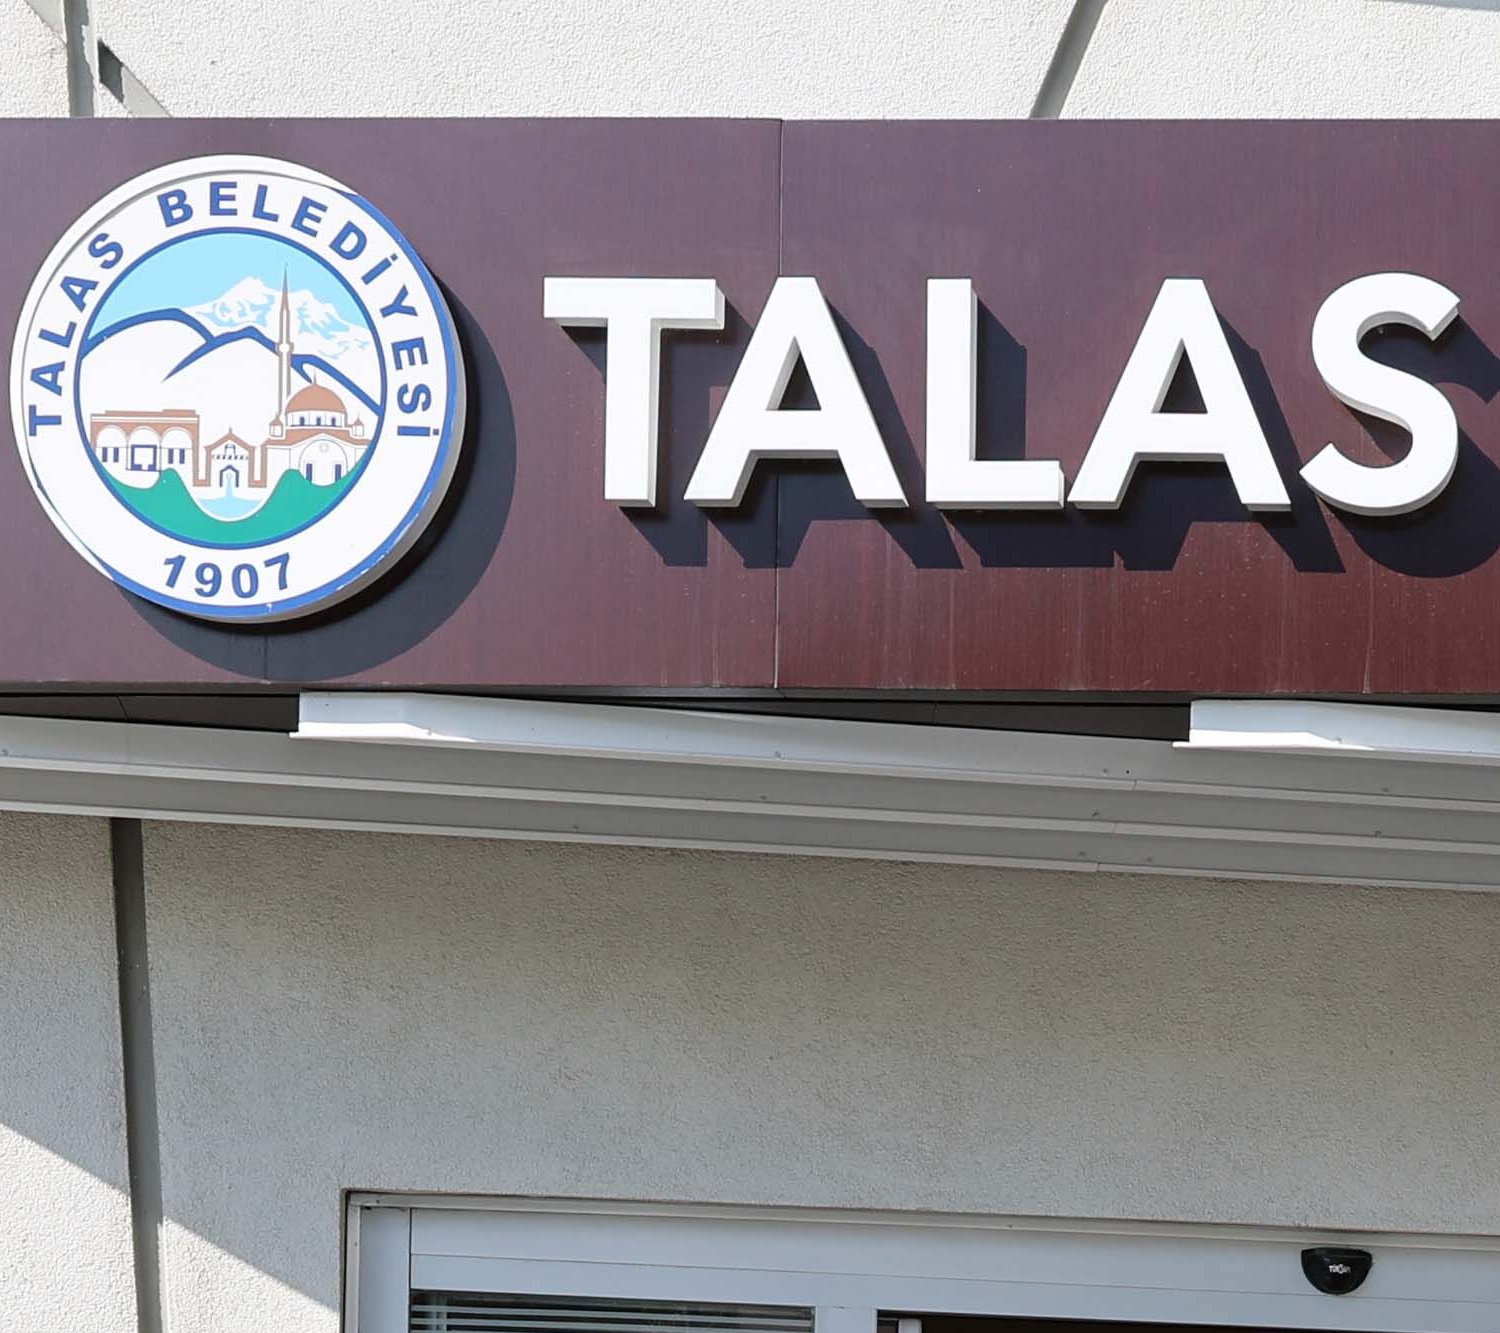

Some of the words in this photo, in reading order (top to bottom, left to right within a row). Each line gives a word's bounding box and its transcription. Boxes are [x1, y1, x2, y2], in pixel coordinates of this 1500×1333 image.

[29, 232, 124, 437] TALAS
[157, 181, 440, 438] BELEDİYESİ
[543, 271, 1461, 516] TALAS
[163, 552, 292, 599] 1907
